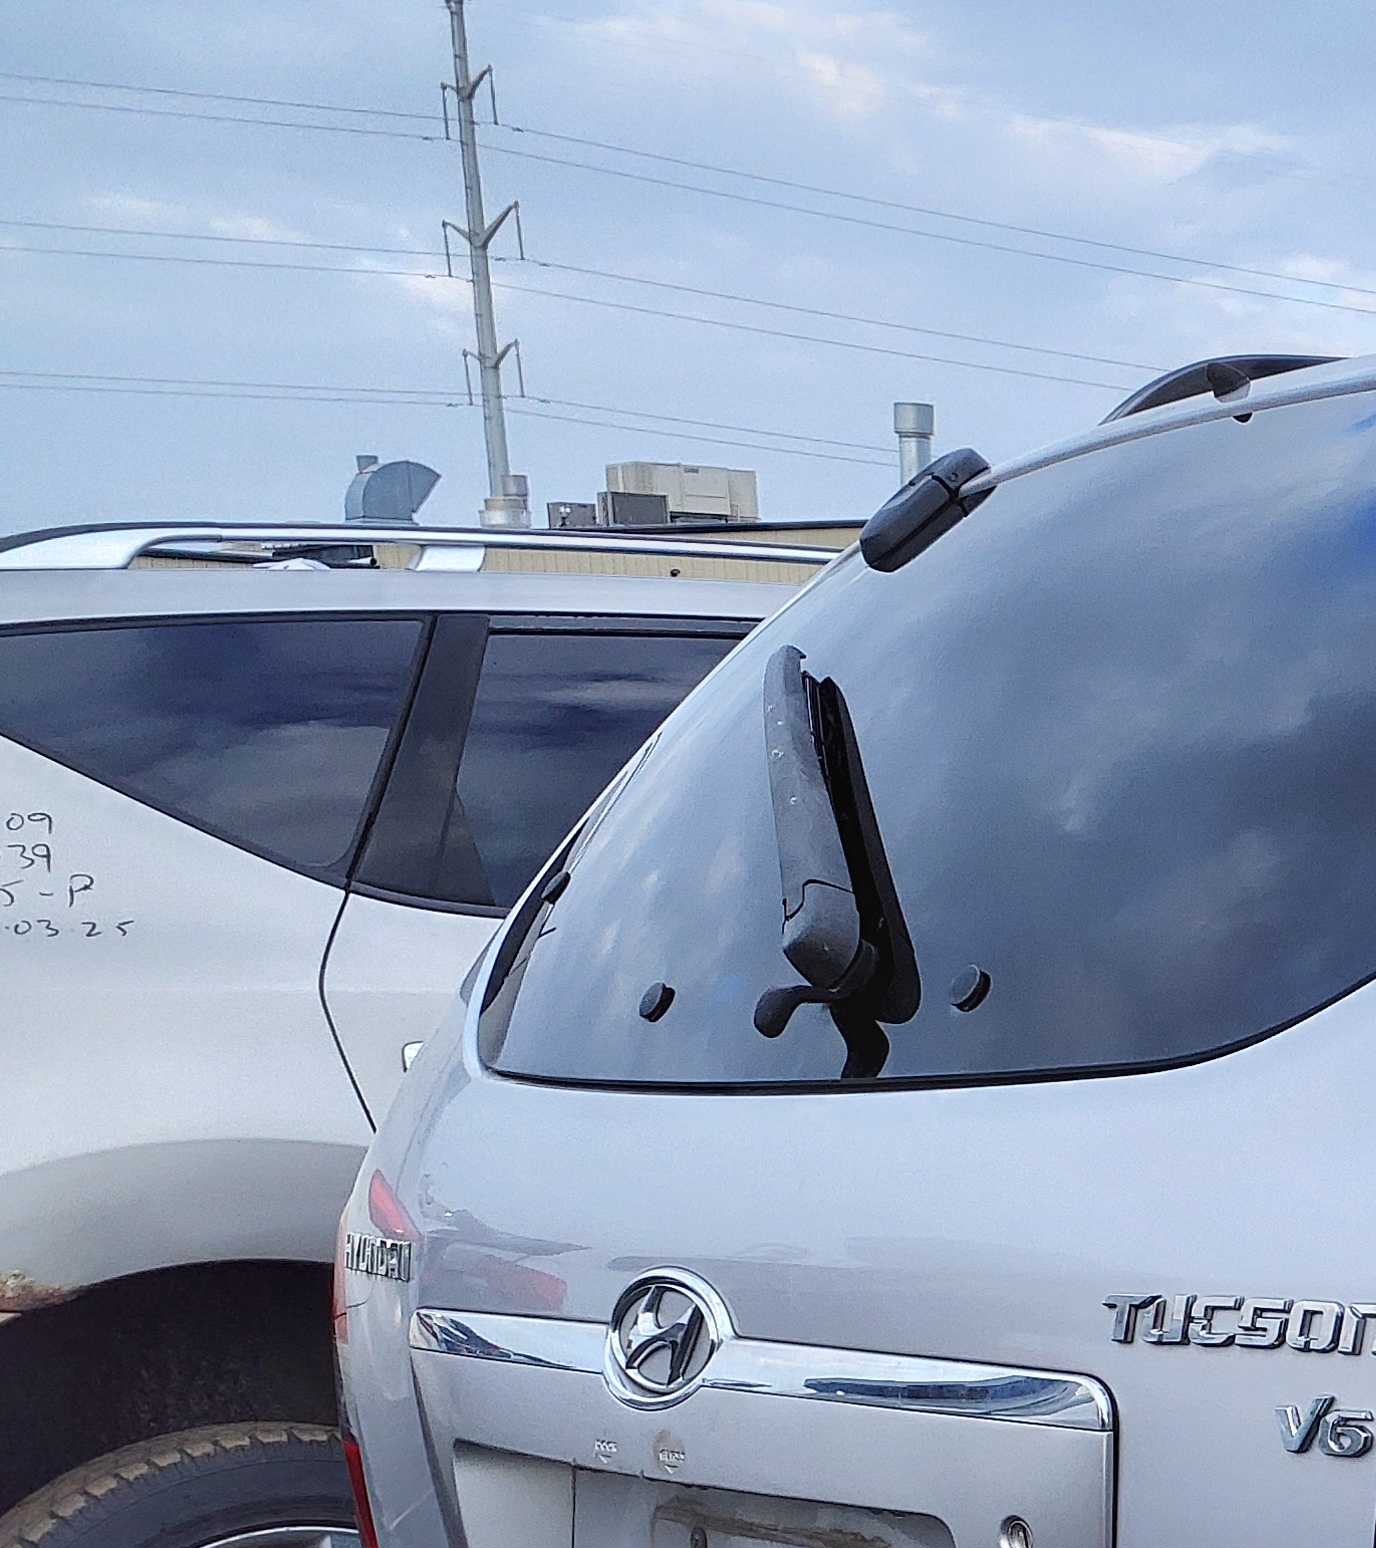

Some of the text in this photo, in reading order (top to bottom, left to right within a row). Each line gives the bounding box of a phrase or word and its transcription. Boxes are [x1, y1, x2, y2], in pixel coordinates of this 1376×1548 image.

[6, 812, 53, 835] 09
[7, 843, 52, 873] 39
[344, 1232, 412, 1283] HYUNDAI
[1274, 1394, 1375, 1458] V6
